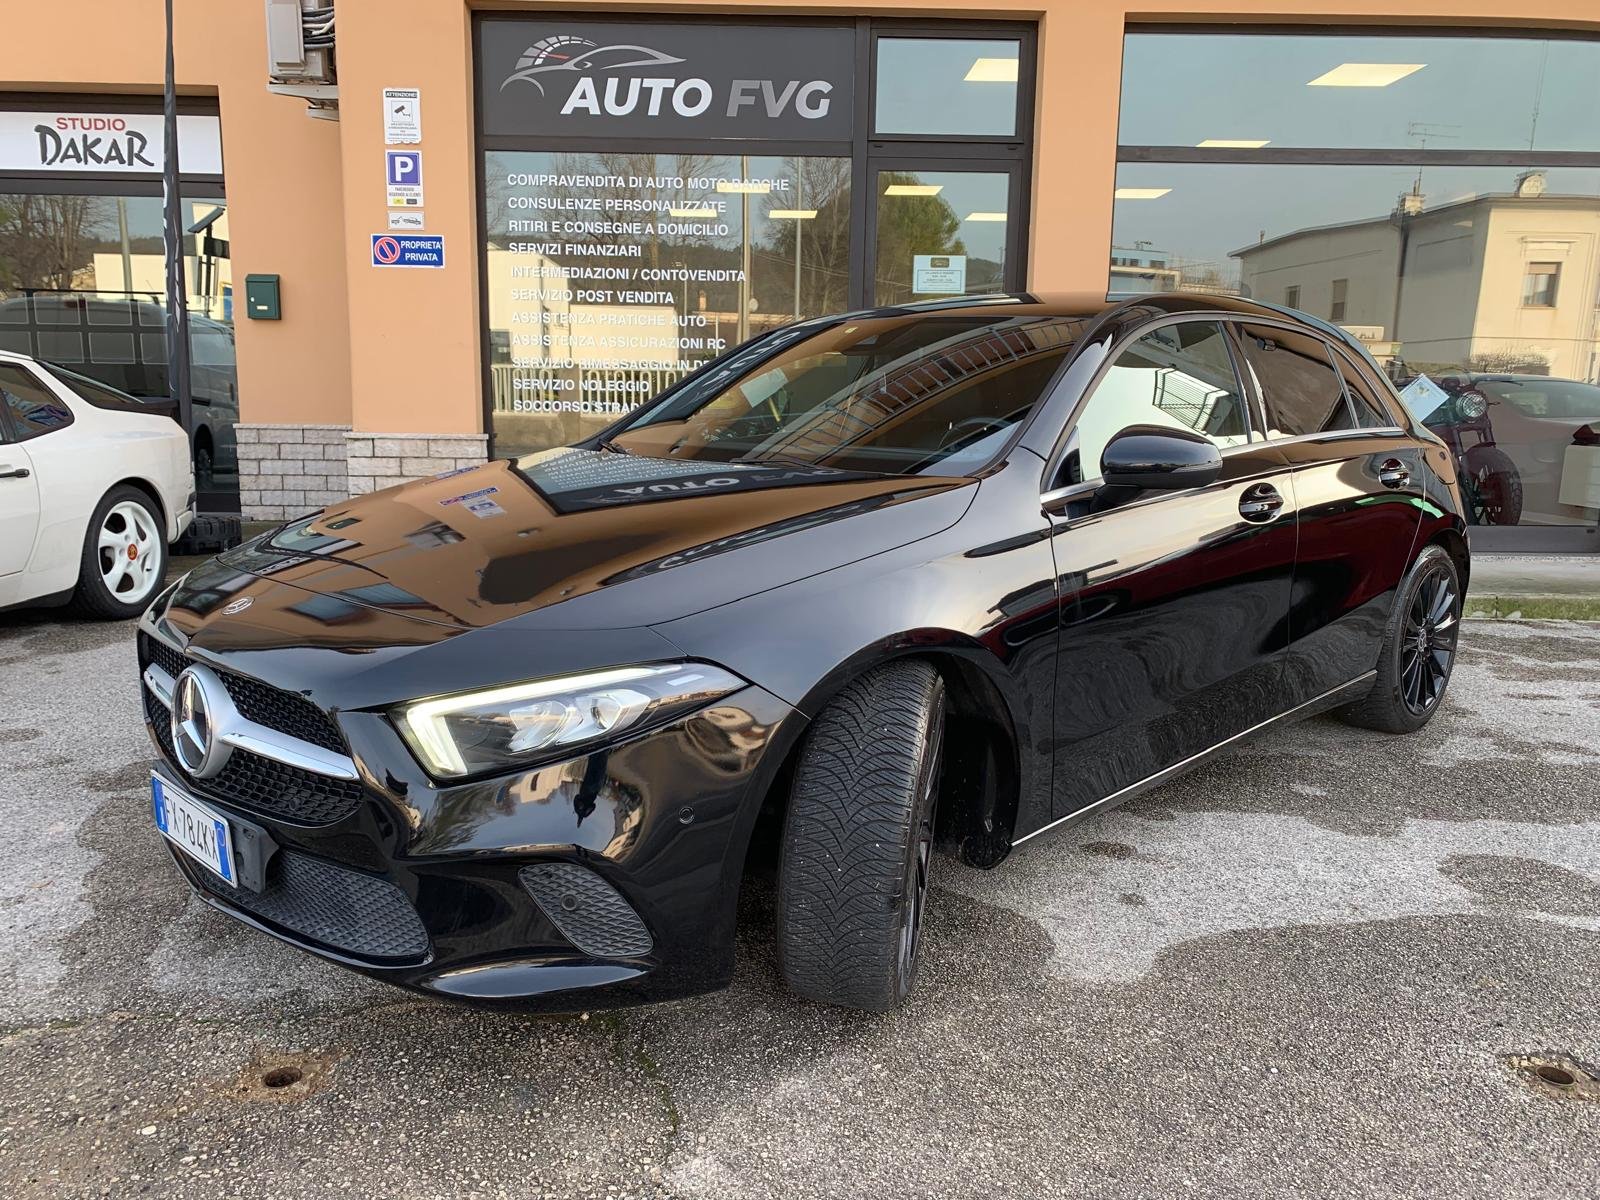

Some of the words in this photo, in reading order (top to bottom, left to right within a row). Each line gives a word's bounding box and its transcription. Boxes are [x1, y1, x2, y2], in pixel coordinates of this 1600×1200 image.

[560, 77, 713, 117] AUTO
[726, 79, 833, 120] FVG
[56, 117, 126, 131] STUDIO
[34, 124, 155, 167] DAKAR
[394, 156, 414, 182] P
[507, 174, 625, 188] COMPRAVENDITA
[629, 176, 642, 188] DI
[646, 176, 684, 190] AUTO
[688, 178, 727, 191] MOTO
[508, 197, 602, 210] CONSULENZE
[605, 198, 727, 213] PERSONALIZZATE
[508, 220, 548, 232] RITIRI
[552, 222, 560, 232] E
[564, 222, 642, 234] CONSEGNE
[645, 223, 655, 234] A
[658, 224, 729, 236] DOMICILIO
[405, 252, 438, 261] PRIVATA
[508, 242, 561, 255] SERVIZI
[565, 244, 642, 257] FINANZIARI
[510, 266, 630, 280] INTERMEDIAZIONI
[632, 268, 638, 280] /
[640, 268, 746, 282] CONTOVENDITA
[510, 289, 573, 302] SERVIZIO
[576, 290, 614, 303] POST
[617, 291, 674, 304] VENDITA
[511, 312, 596, 324] ASSISTENZA
[599, 313, 666, 326] PRATICHE
[670, 314, 707, 328] AUTO
[511, 334, 597, 347] ASSISTENZA
[599, 336, 703, 350] ASSICURAZIONI
[707, 338, 726, 350] RC
[512, 356, 574, 370] SERVIZIO
[578, 358, 673, 370] RIMESSAGGIO
[676, 359, 690, 370] IN
[512, 378, 575, 391] SERVIZIO
[578, 380, 650, 392] NOLEGGIO
[513, 400, 591, 412] SOCCORSO
